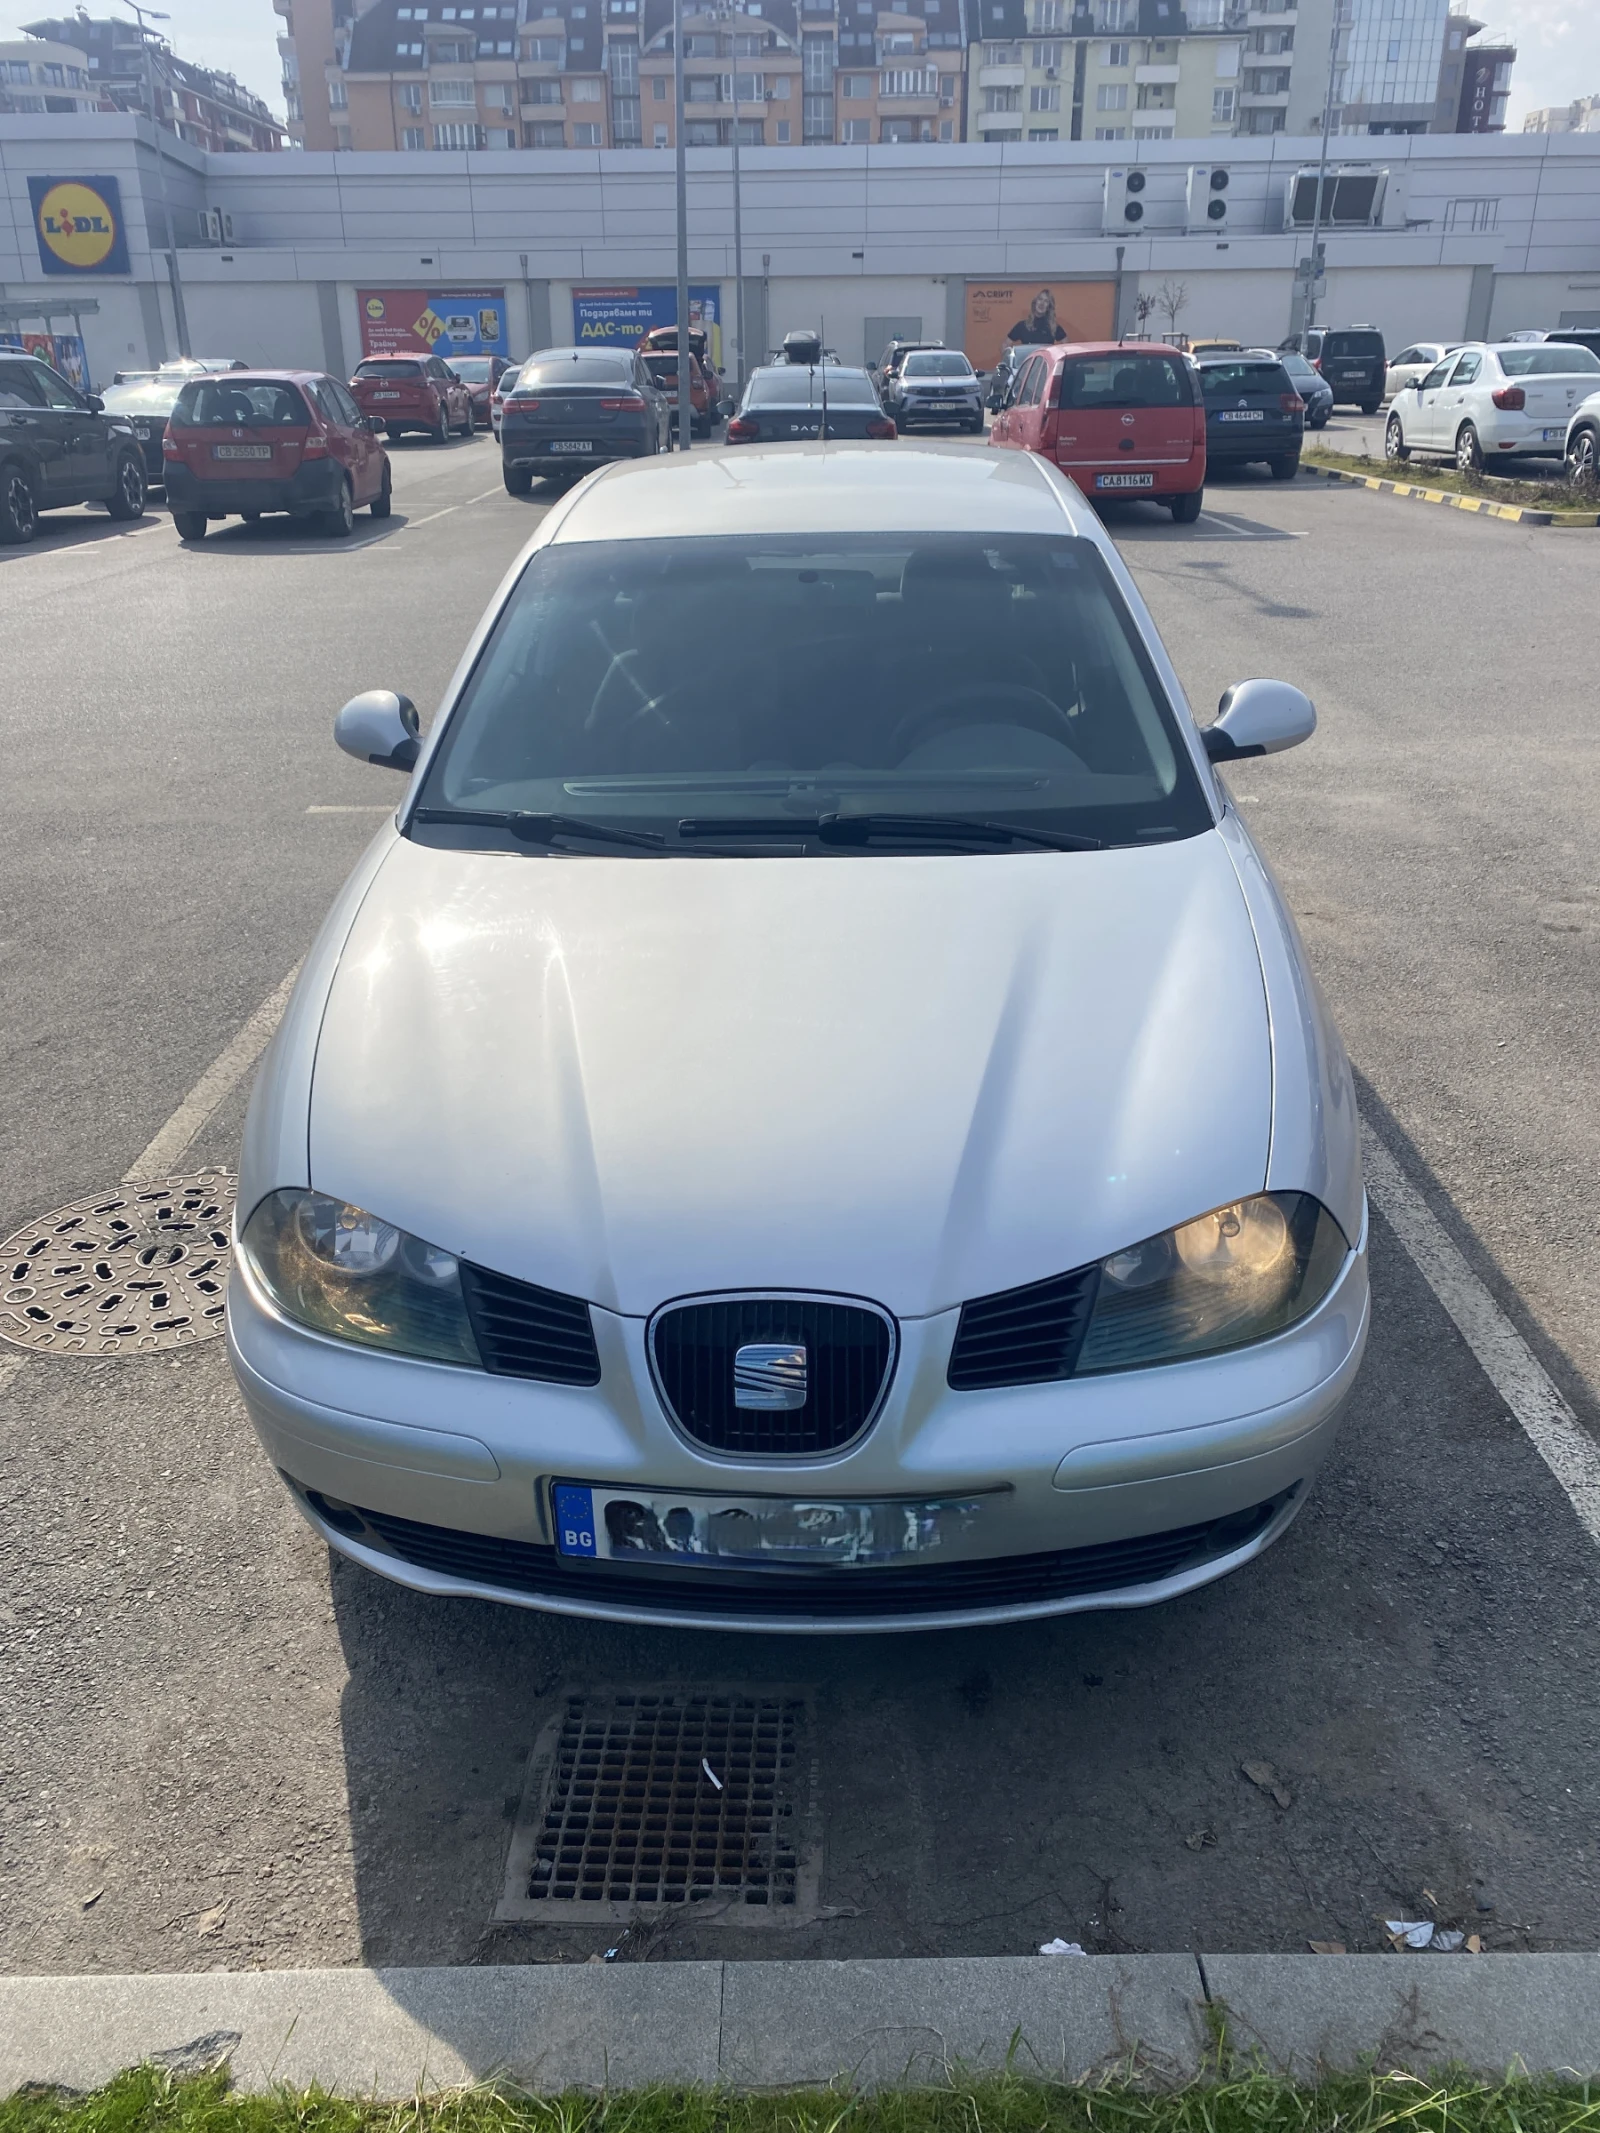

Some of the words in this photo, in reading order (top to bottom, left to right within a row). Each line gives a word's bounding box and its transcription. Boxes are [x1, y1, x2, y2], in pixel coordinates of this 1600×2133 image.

[1472, 87, 1486, 134] HOT
[580, 308, 637, 319] Подаряваме
[581, 322, 644, 338] ДДС-то
[790, 424, 835, 432] DACA
[1116, 476, 1138, 486] 8116
[565, 1530, 592, 1547] BG
